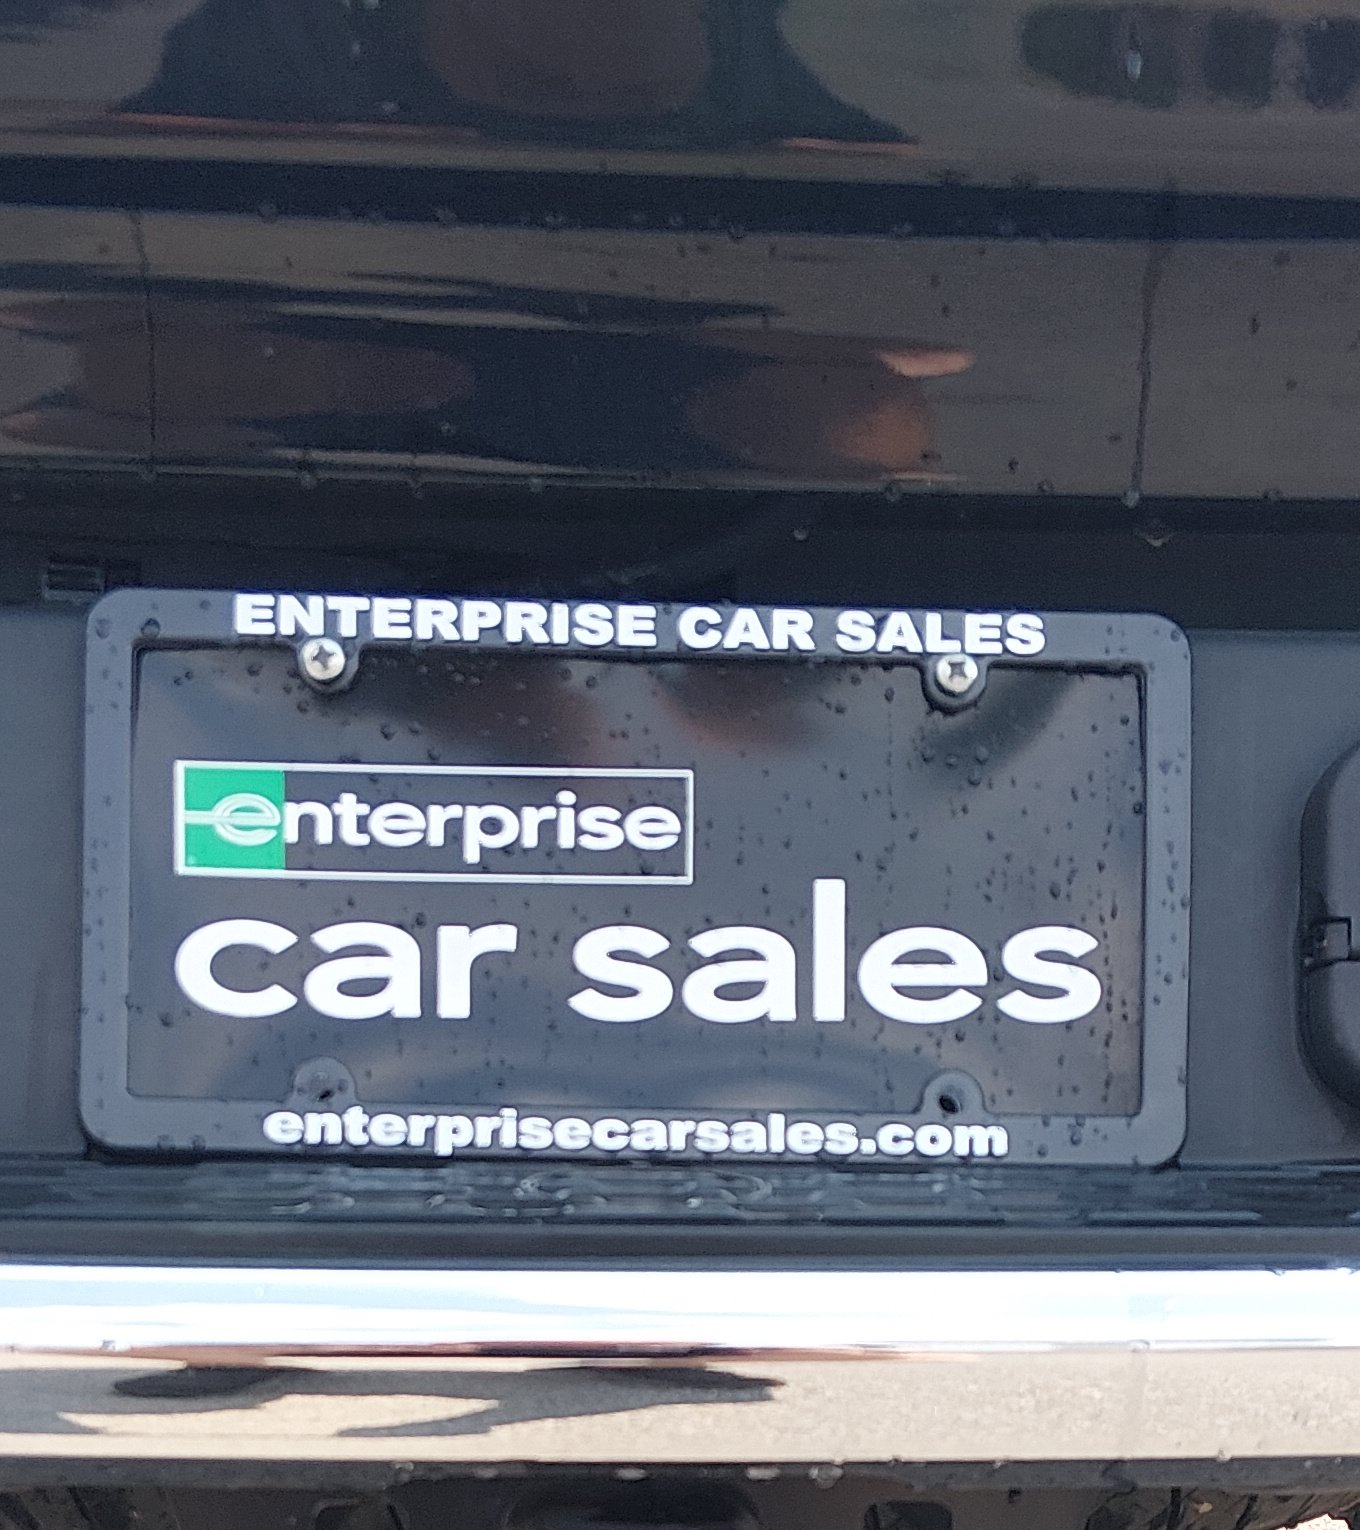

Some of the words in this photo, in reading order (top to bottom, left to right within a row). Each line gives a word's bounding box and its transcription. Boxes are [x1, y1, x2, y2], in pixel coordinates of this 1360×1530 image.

[233, 593, 658, 648] ENTERPRISE
[676, 606, 816, 651] CAR
[835, 610, 1046, 656] SALES
[212, 789, 682, 864] enterprise
[174, 918, 518, 1020] car
[567, 878, 1102, 1025] sales
[262, 1105, 1009, 1157] enterprisecarsales.com
